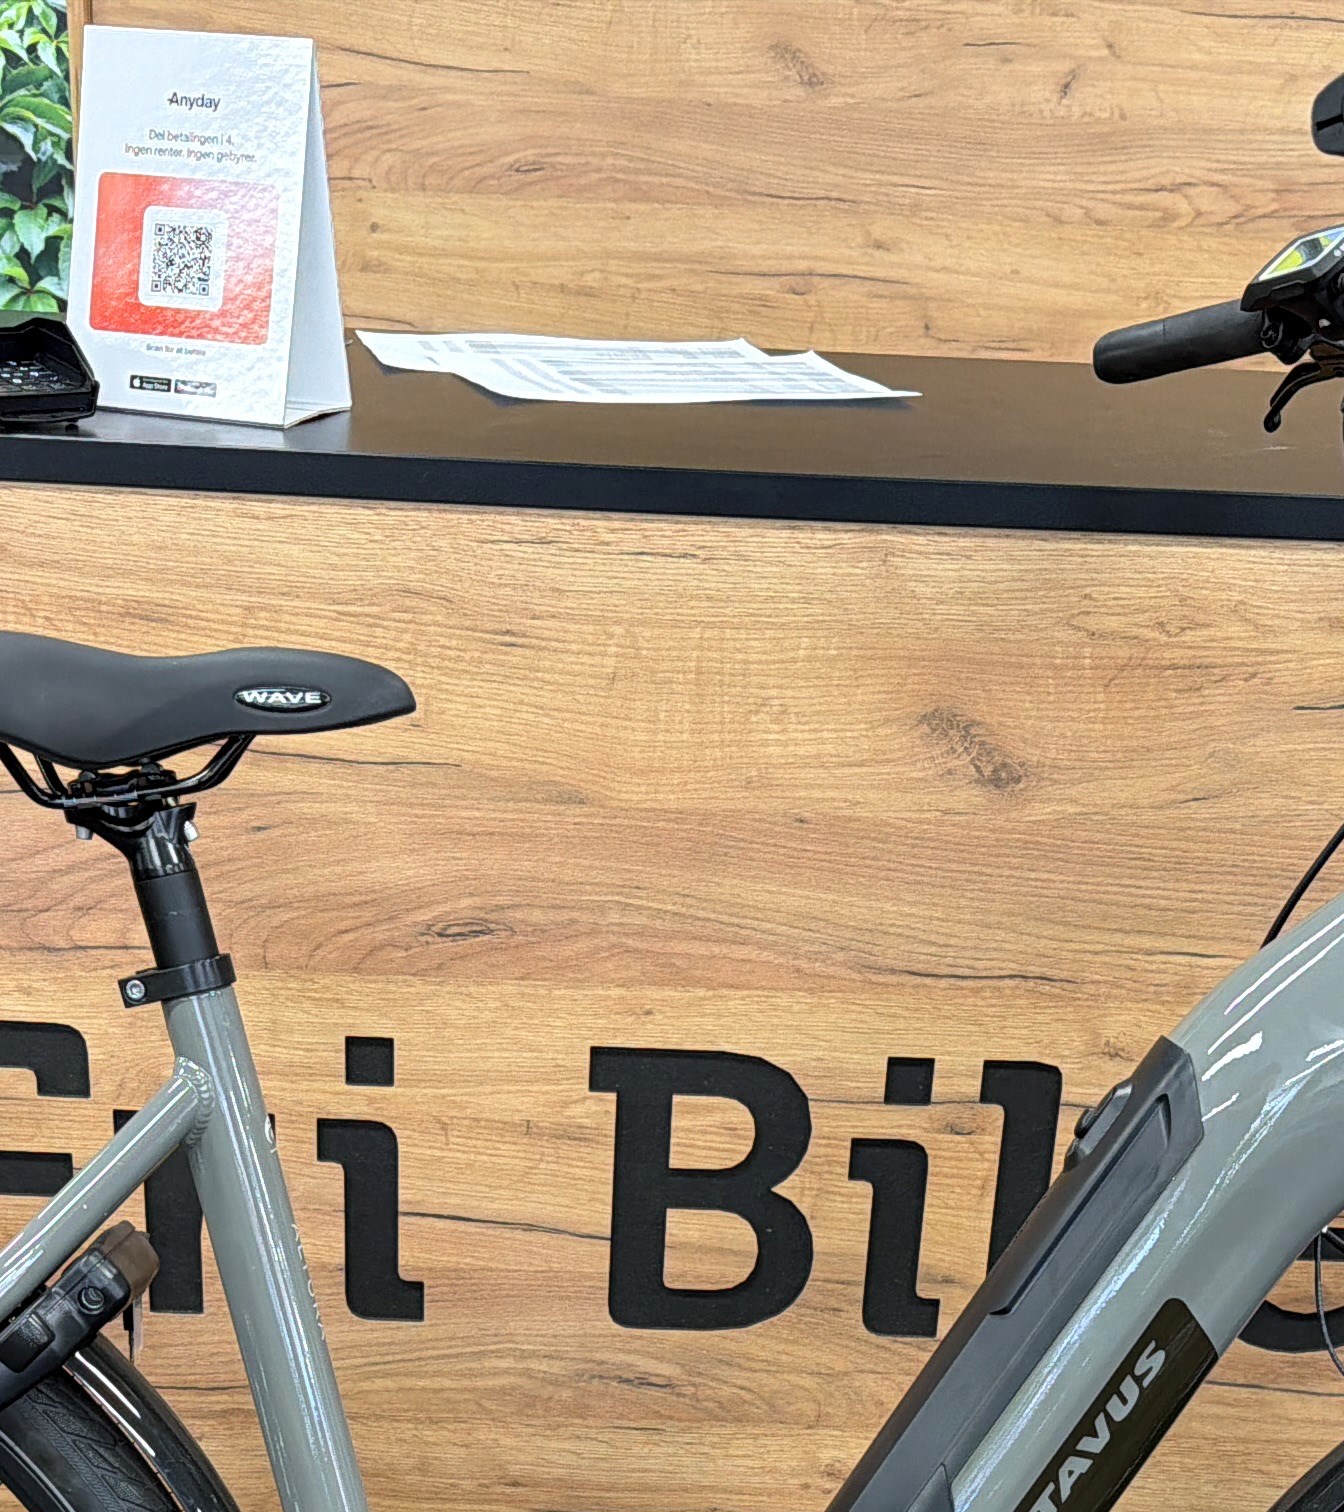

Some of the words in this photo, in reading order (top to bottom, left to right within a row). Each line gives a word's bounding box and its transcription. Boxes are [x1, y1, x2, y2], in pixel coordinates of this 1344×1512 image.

[167, 92, 221, 112] Anyday
[125, 143, 152, 157] Ingen
[242, 691, 322, 704] WAVE
